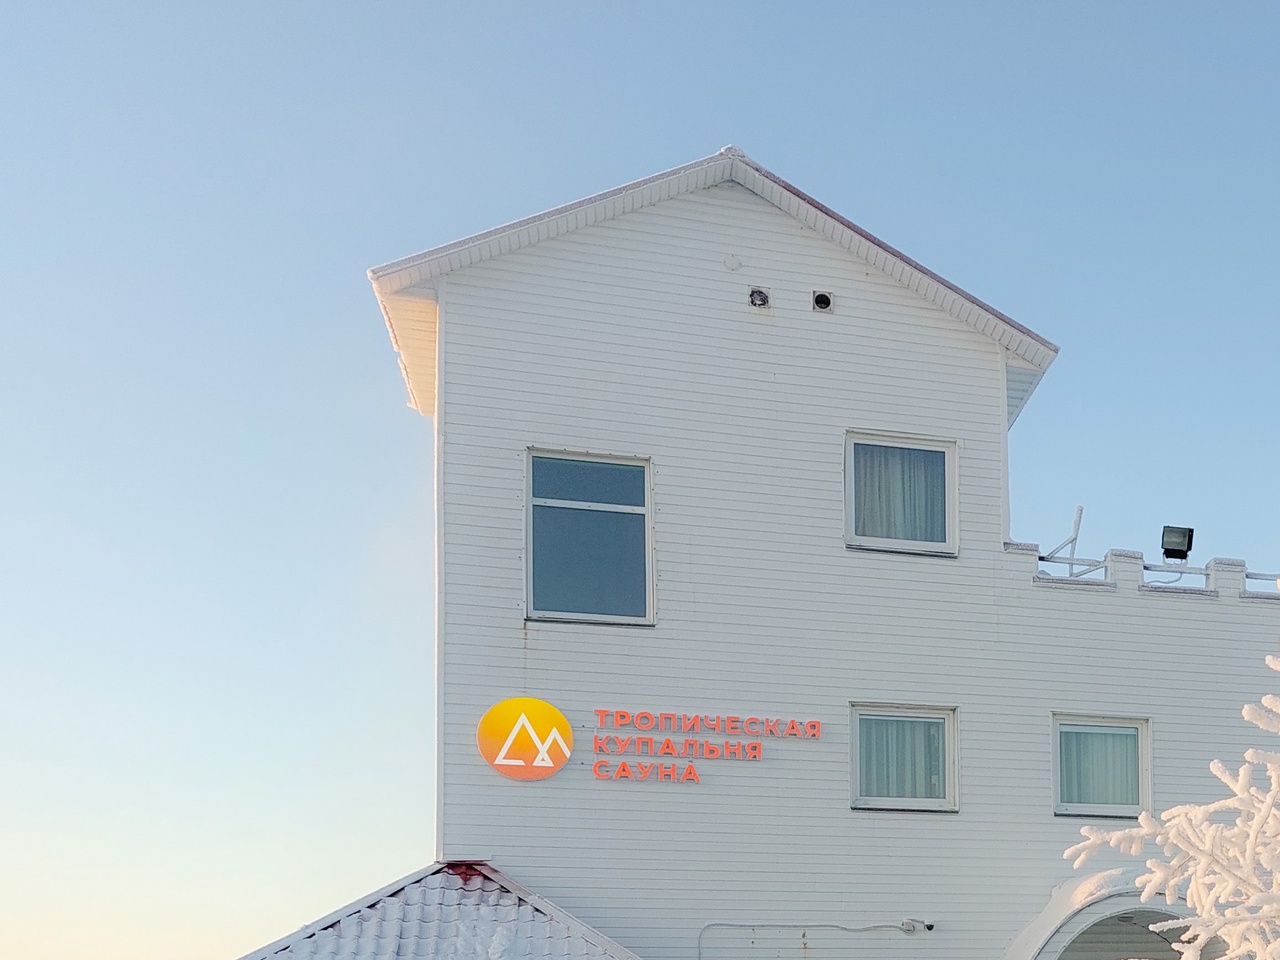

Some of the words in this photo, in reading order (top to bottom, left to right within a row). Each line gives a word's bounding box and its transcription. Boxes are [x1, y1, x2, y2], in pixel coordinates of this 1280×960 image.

[593, 708, 822, 739] ТРОПИЧЕСКАЯ
[592, 735, 763, 761] КУПАЛЬНЯ
[591, 760, 701, 784] САУНА
